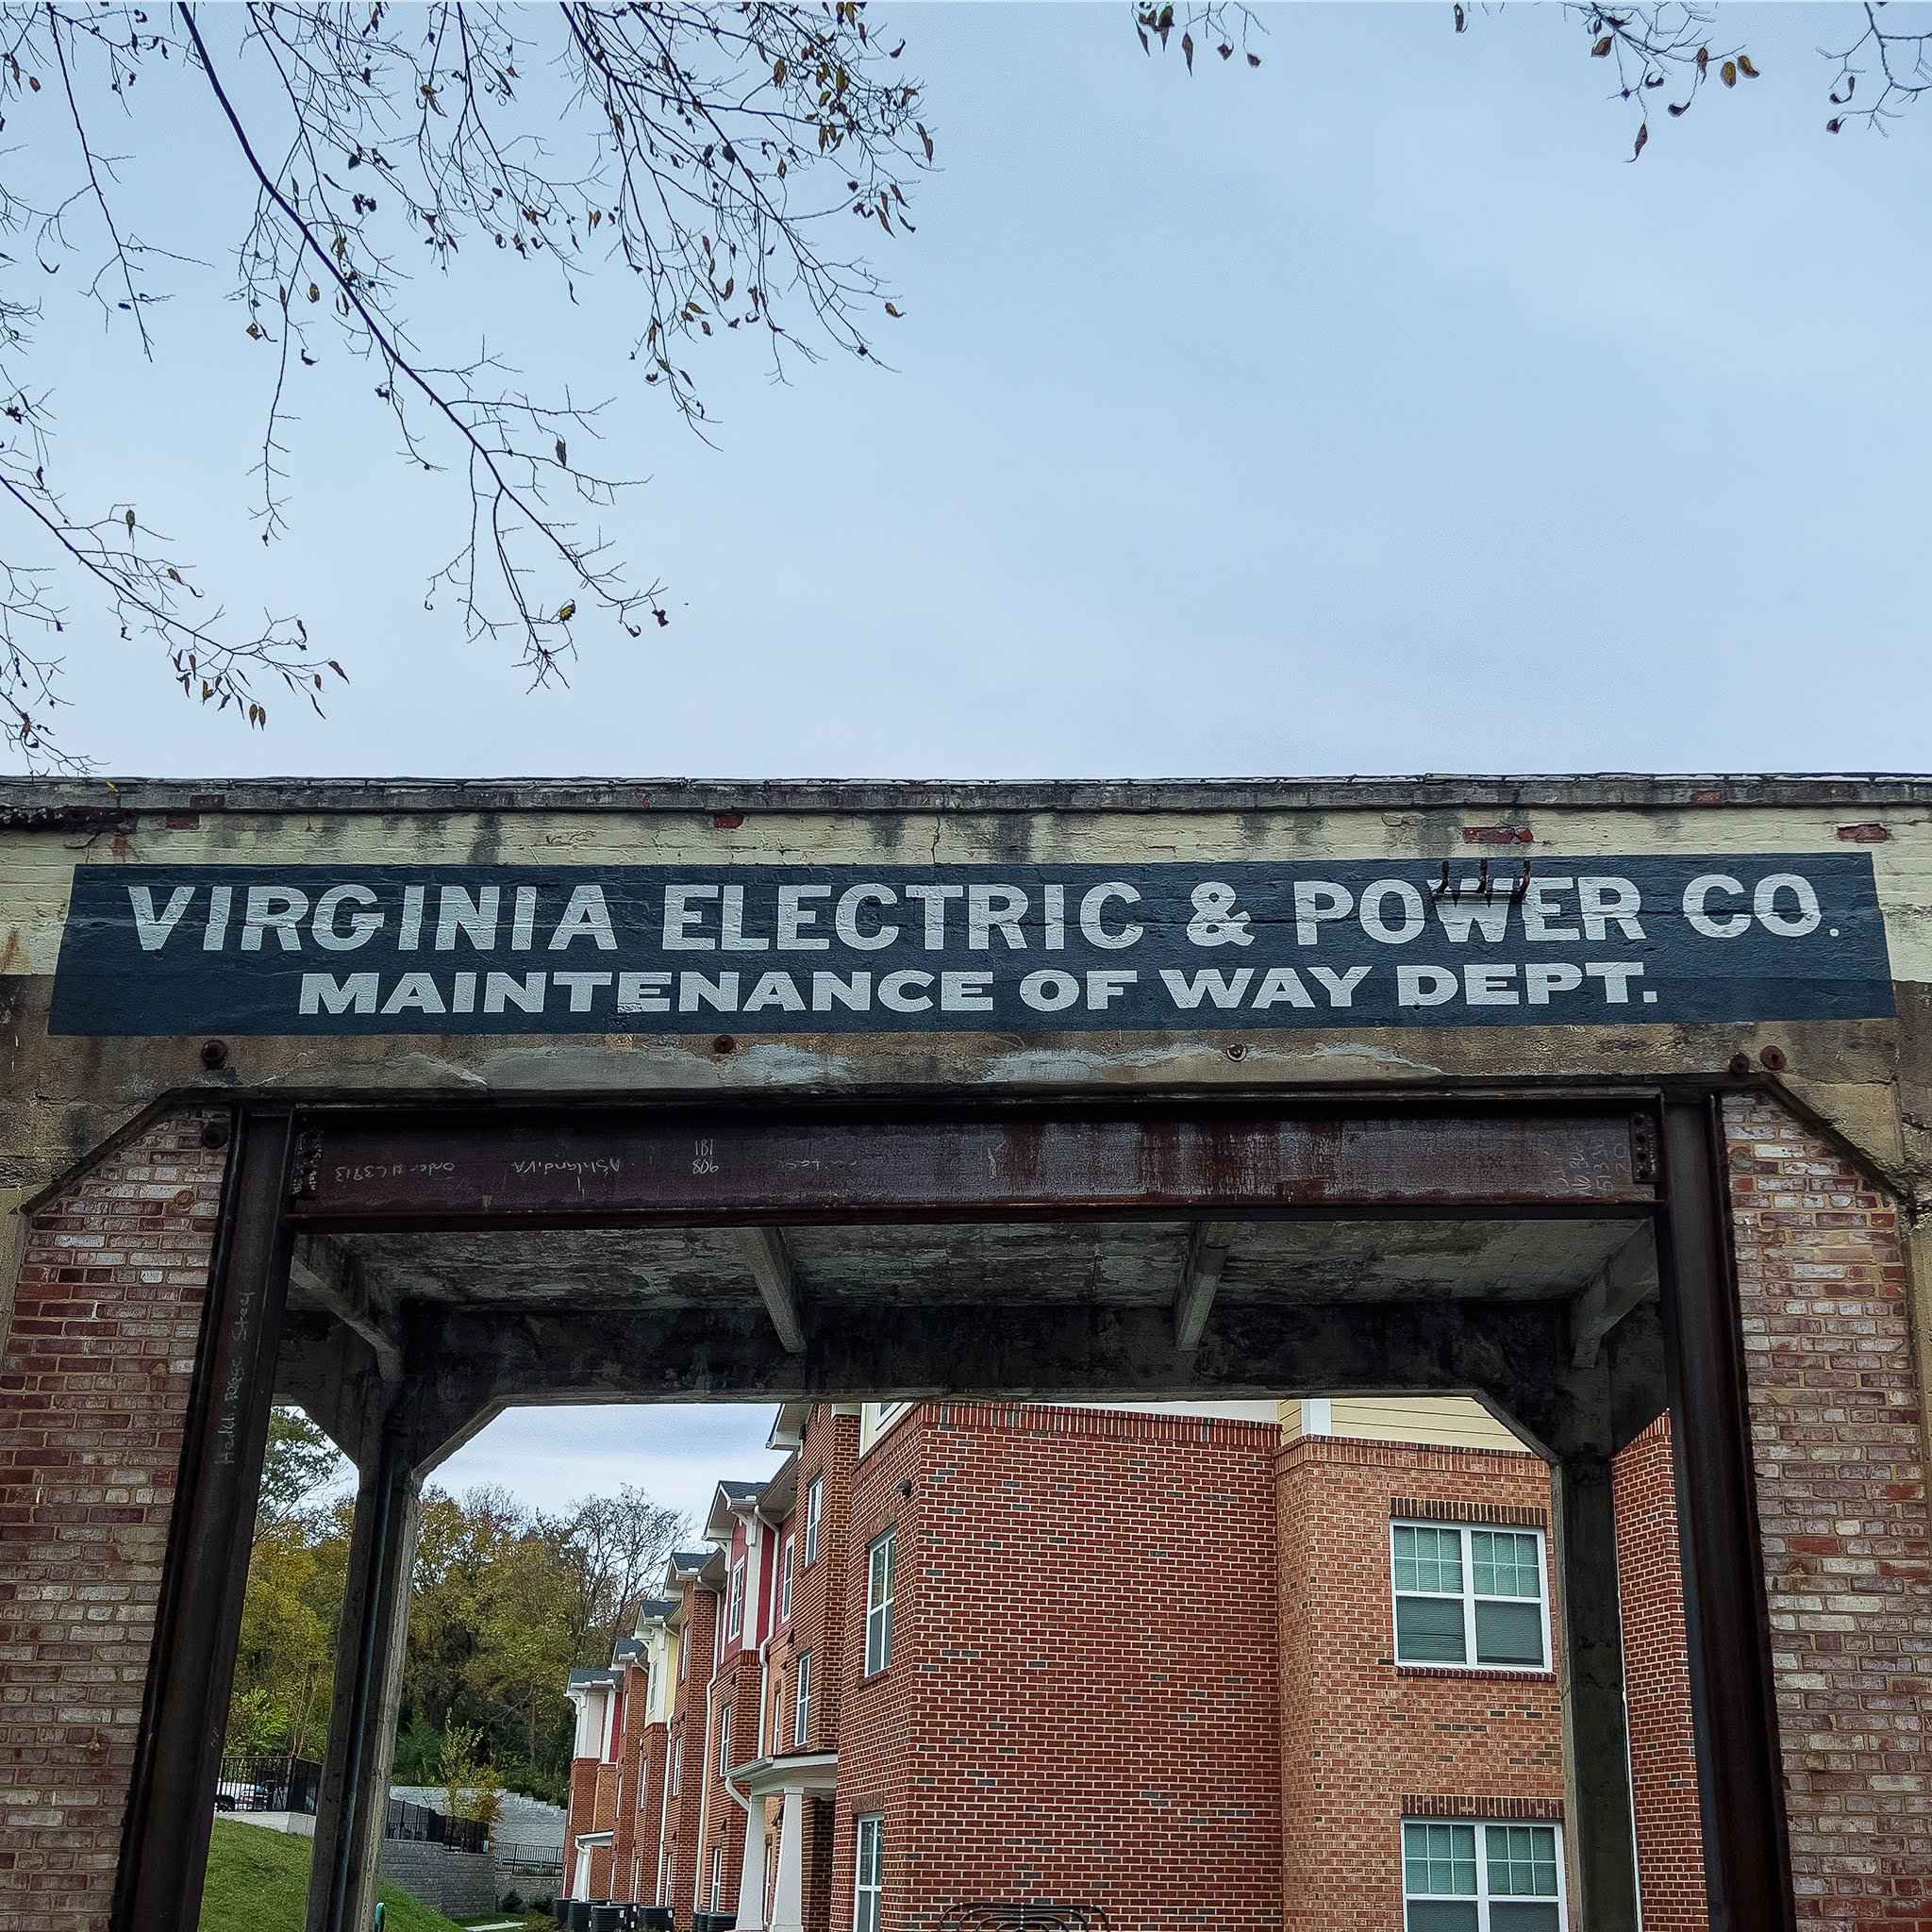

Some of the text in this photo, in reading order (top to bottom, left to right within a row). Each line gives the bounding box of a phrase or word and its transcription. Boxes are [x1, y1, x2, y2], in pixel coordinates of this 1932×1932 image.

[127, 872, 1840, 951] VIRGINIA ELECTRIC & POWER CO.
[298, 961, 1658, 1015] MAINTENANCE OF WAY DEPT.
